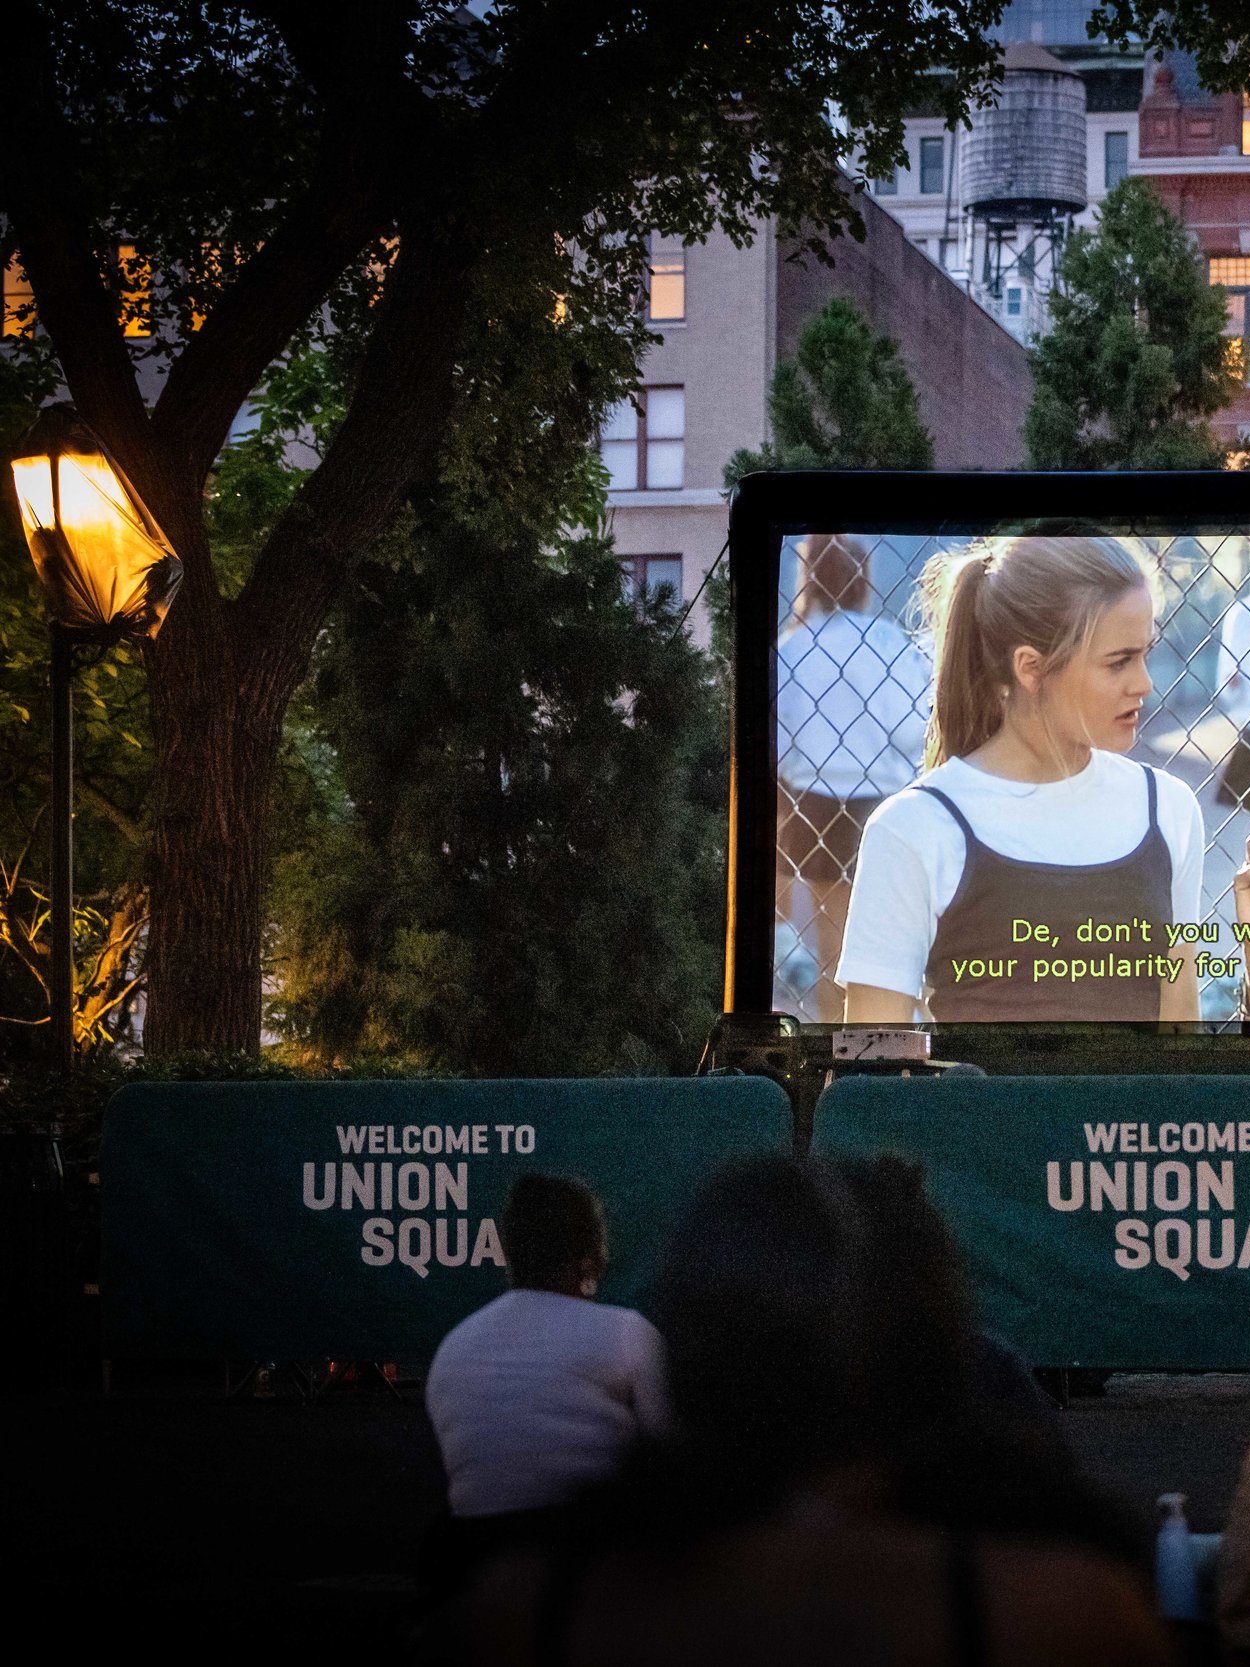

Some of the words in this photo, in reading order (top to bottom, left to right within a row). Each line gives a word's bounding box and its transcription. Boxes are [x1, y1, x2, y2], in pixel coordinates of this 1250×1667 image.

[1011, 918, 1060, 948] De,
[1075, 917, 1152, 943] don't
[1165, 922, 1218, 948] you
[951, 958, 1019, 983] your
[1032, 952, 1184, 983] popularity
[1195, 951, 1240, 977] for
[336, 1125, 490, 1154] WELCOME
[494, 1124, 537, 1154] TO
[302, 1162, 469, 1211] UNION
[1046, 1160, 1236, 1212] UNION
[360, 1217, 508, 1279] SQUA
